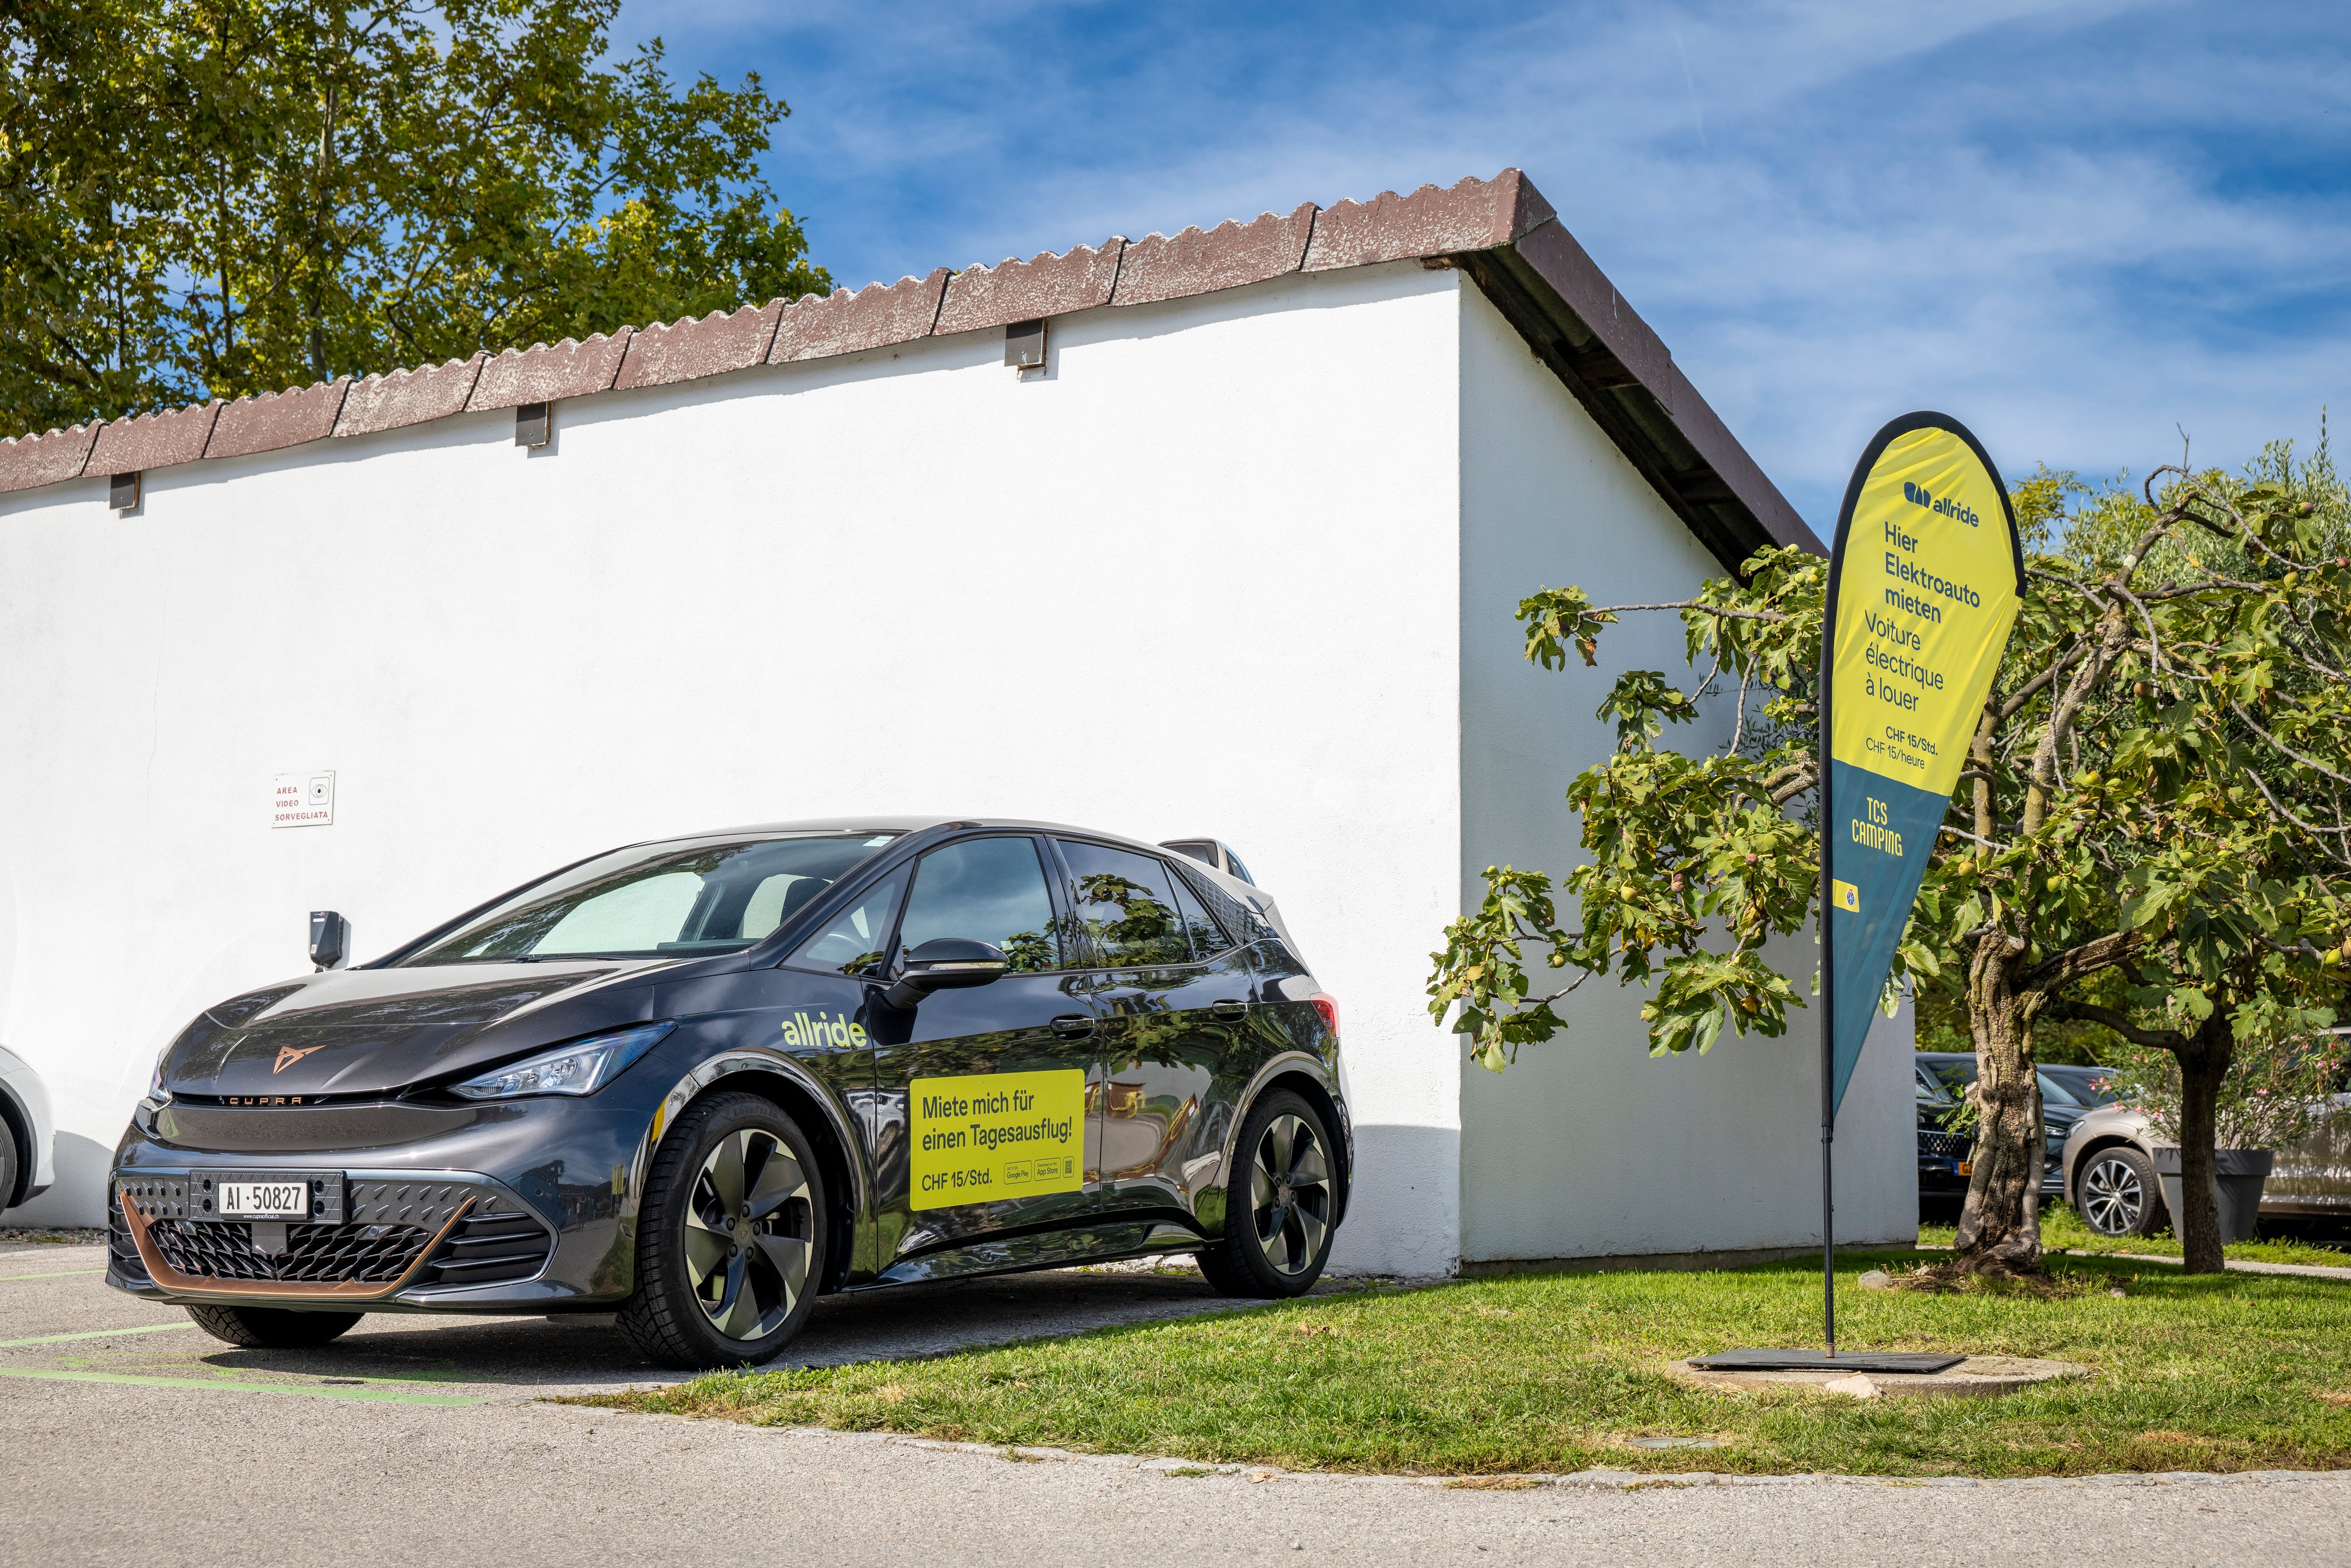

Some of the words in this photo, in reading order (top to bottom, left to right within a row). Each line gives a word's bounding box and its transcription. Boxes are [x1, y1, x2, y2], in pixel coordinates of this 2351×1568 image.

[1933, 498, 1979, 527] allride
[1884, 521, 1918, 553] Hier
[1886, 551, 1980, 608] Elektroauto
[1886, 588, 1941, 624] mieten
[1864, 609, 1921, 651] Voiture
[1866, 642, 1943, 690] électrique
[1866, 672, 1875, 697] à
[1880, 677, 1919, 712] louer
[1866, 737, 1885, 755] CHF
[1887, 744, 1925, 769] 15/heure
[1886, 725, 1905, 743] CHF
[1907, 733, 1938, 756] 15/Std.
[276, 786, 298, 794] AREA
[276, 799, 299, 808] VIDEO
[275, 811, 328, 821] SORVEGLIATA
[1867, 797, 1888, 825] TCS
[1852, 818, 1903, 857] CAMPING
[781, 1011, 868, 1047] allride
[230, 1097, 303, 1105] CUPRA
[922, 1095, 968, 1120] Miete
[972, 1091, 1009, 1115] mich
[1012, 1089, 1034, 1112] für
[922, 1128, 966, 1151] einen
[970, 1116, 1072, 1151] Tagesausflug!
[921, 1172, 948, 1191] CHF
[951, 1168, 992, 1188] 15/Std.
[1007, 1171, 1021, 1179] Google
[1037, 1168, 1046, 1177] App
[227, 1186, 240, 1210] AI
[253, 1186, 302, 1210] 50827
